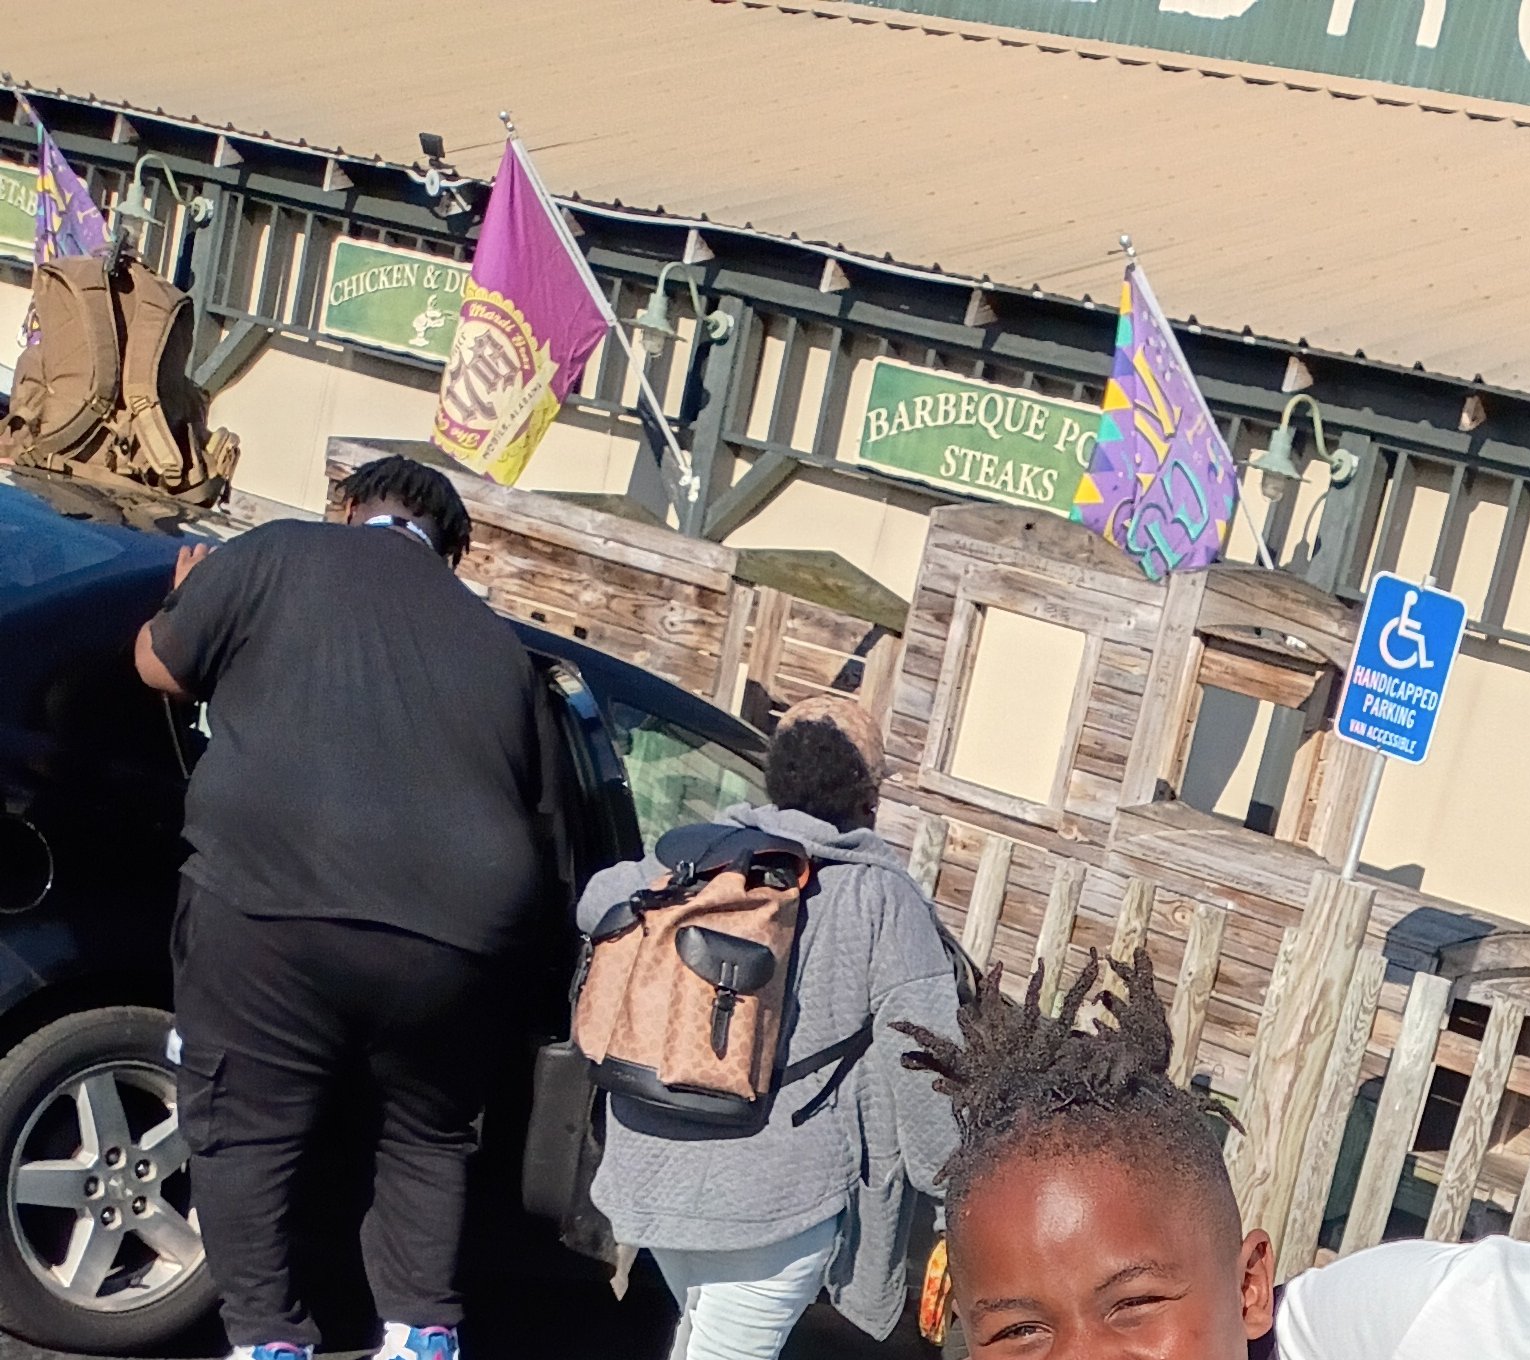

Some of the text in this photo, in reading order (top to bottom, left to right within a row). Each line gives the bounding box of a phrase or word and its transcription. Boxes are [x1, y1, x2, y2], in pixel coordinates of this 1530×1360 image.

[330, 263, 420, 305] CHICKEN
[423, 264, 442, 290] &
[867, 391, 1098, 469] BARBEQUE PO
[940, 444, 1059, 502] STEAKS
[1352, 664, 1439, 712] HANDICAPPED
[1362, 693, 1417, 729] PARKING
[1349, 718, 1417, 755] VAN ACCESSIBLE
